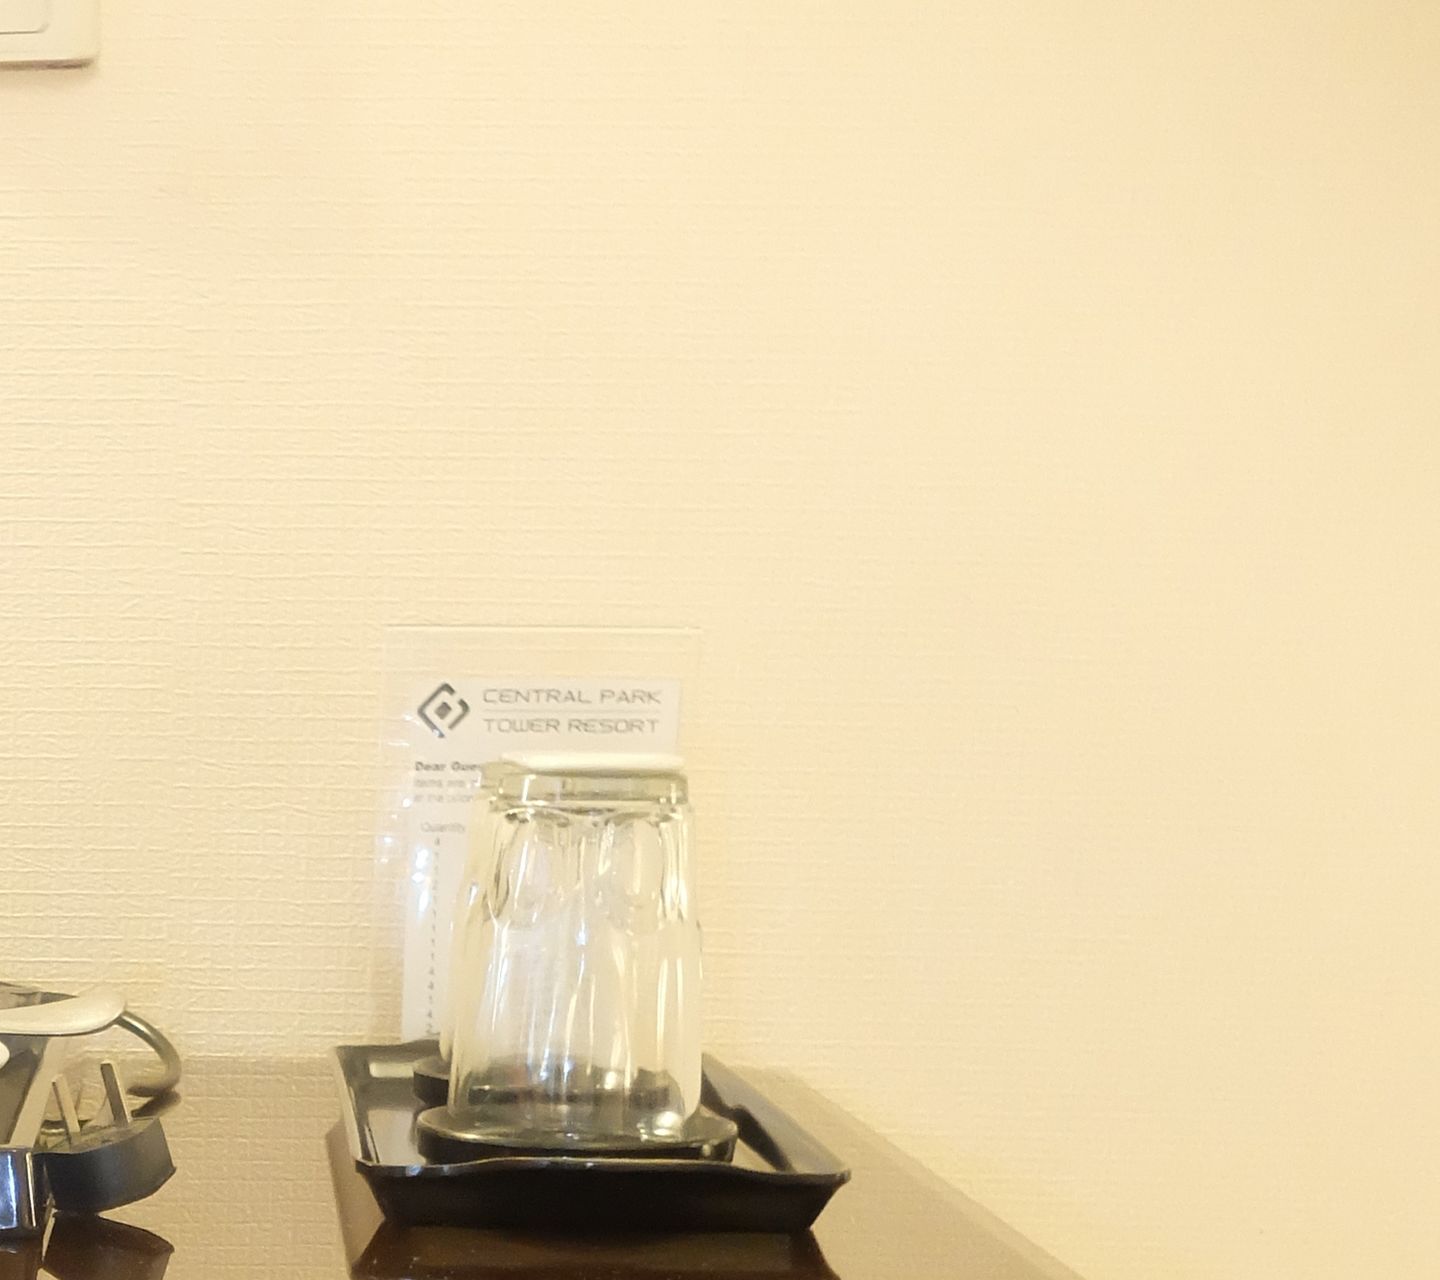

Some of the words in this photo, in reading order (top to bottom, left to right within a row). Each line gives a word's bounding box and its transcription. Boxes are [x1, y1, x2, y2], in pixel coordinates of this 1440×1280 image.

[482, 688, 591, 705] CENTRAL
[599, 689, 662, 705] PARK
[482, 718, 561, 734] TOWER
[568, 718, 660, 734] RESORT
[415, 761, 446, 772] Dear
